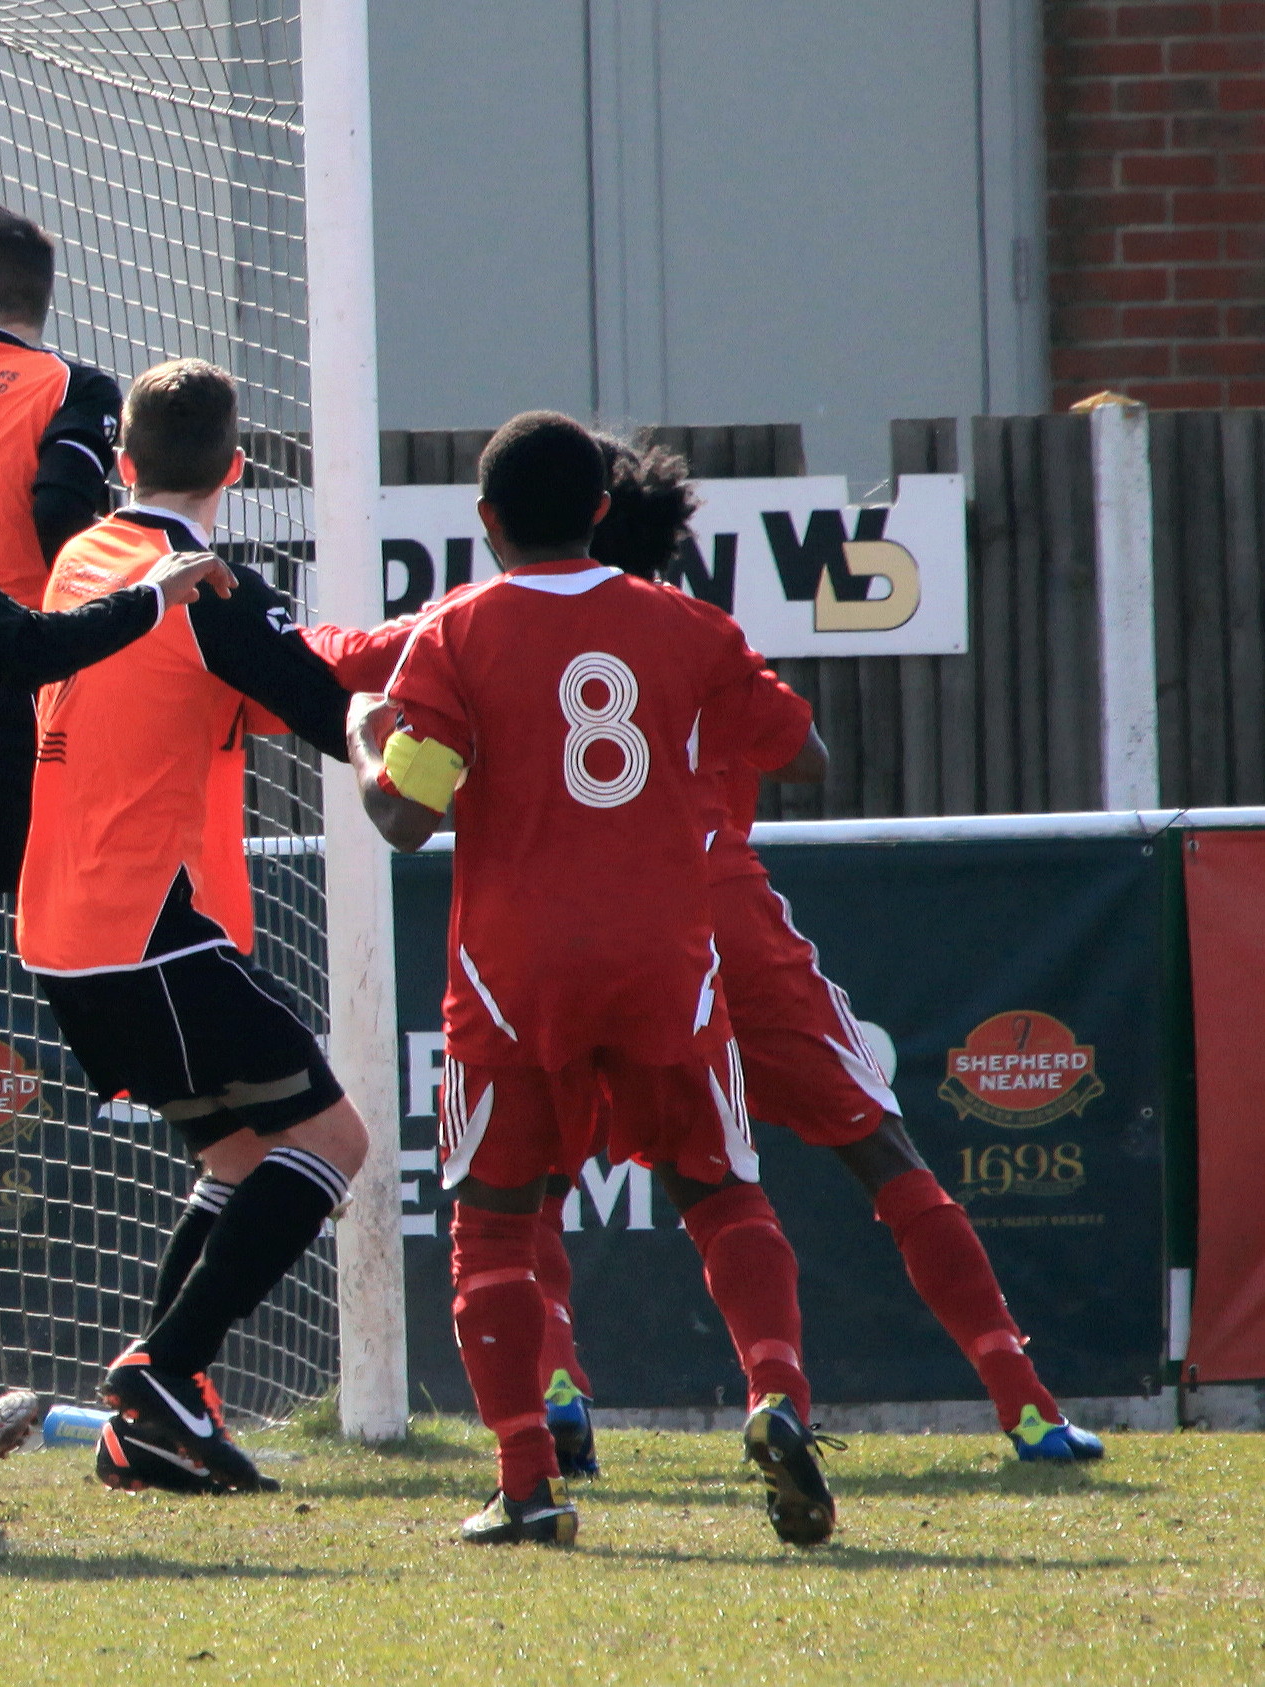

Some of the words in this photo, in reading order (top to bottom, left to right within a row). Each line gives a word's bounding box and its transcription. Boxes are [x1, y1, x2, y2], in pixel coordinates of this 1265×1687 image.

[559, 651, 650, 808] 8
[955, 1052, 1088, 1072] SHEPHERD
[979, 1073, 1063, 1091] NEAME
[958, 1142, 1084, 1195] 1698
